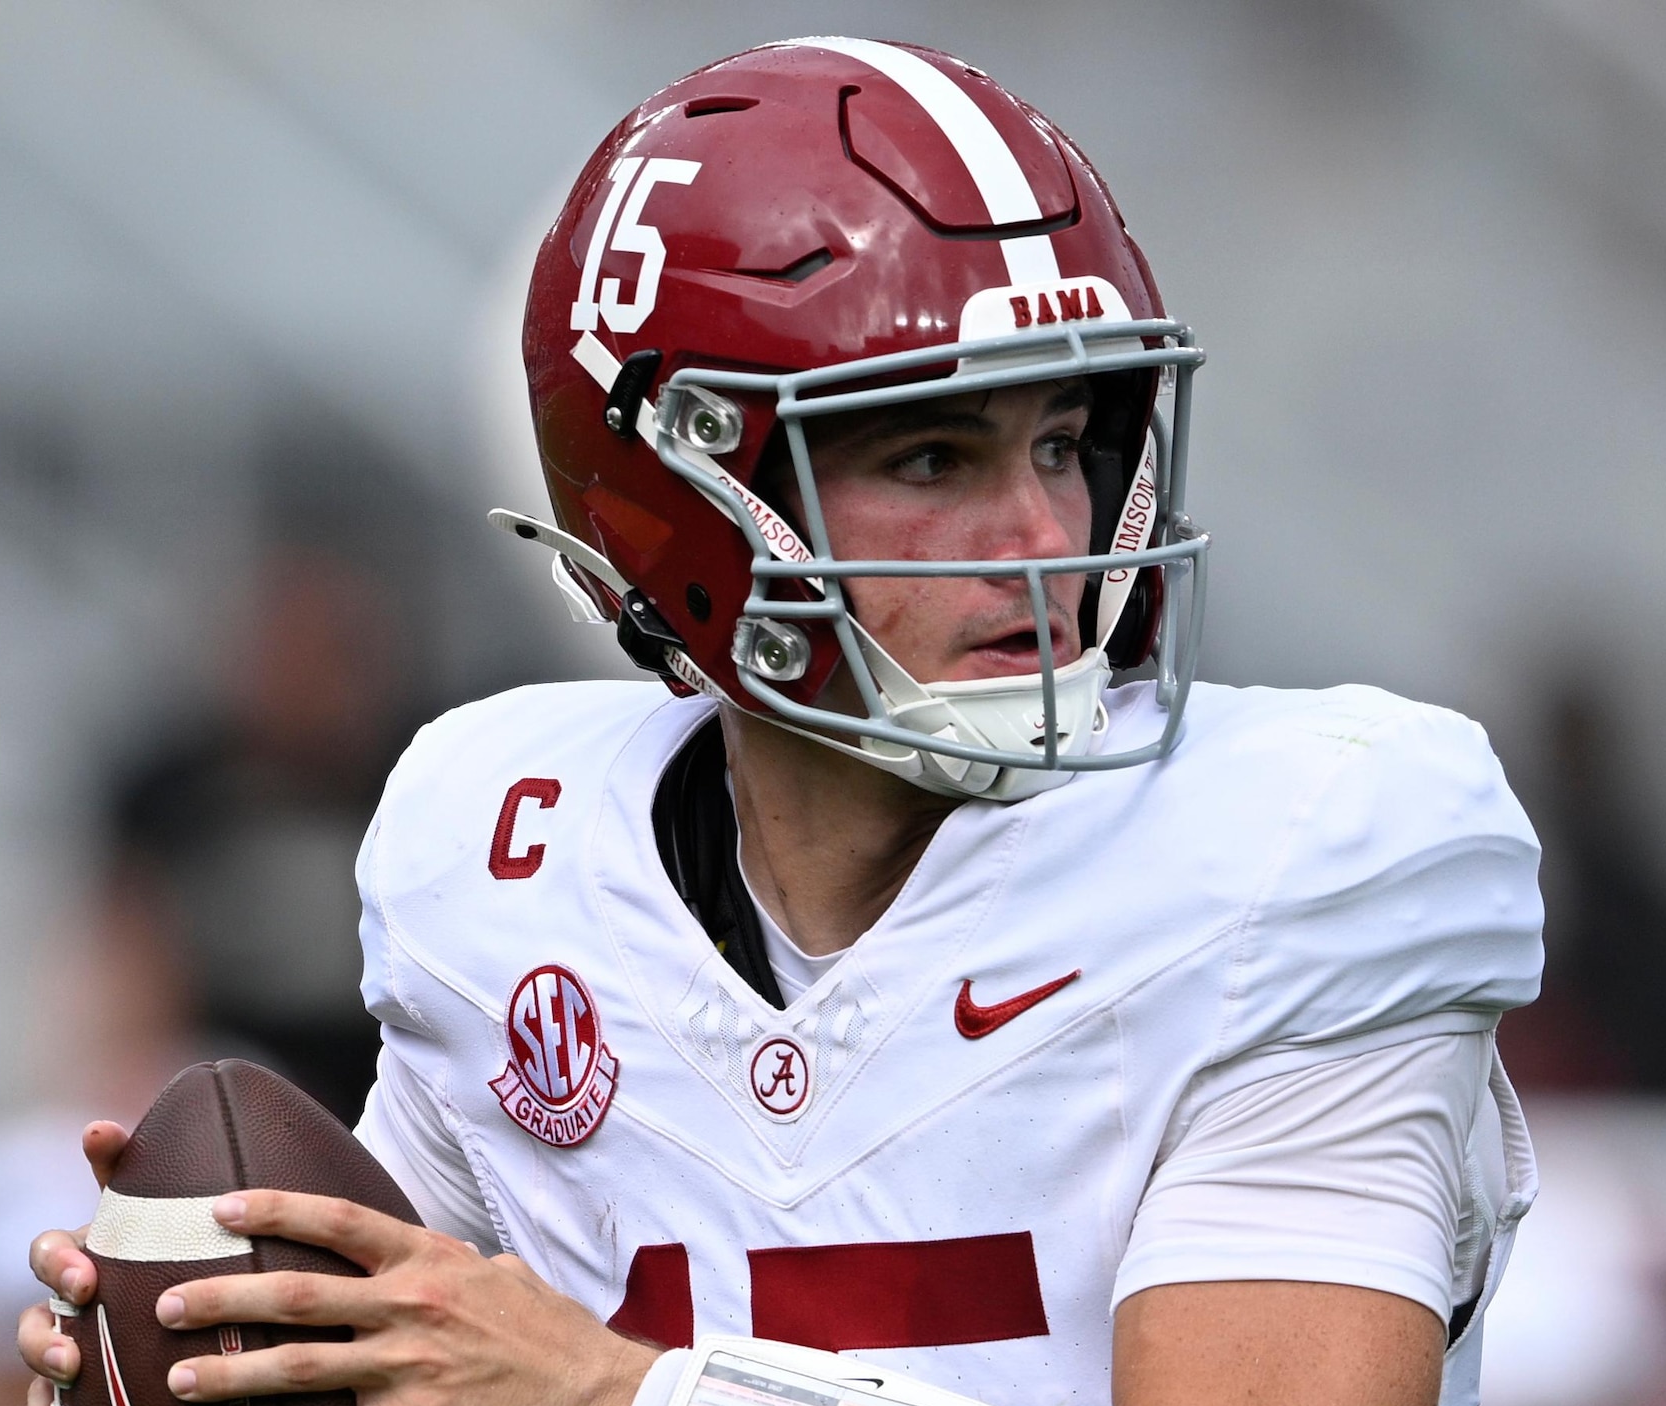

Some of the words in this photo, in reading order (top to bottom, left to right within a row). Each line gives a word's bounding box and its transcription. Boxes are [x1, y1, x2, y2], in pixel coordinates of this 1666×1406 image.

[570, 157, 702, 334] 15
[1009, 287, 1104, 328] BAMA
[1107, 475, 1155, 583] CIMSON
[488, 777, 562, 880] C
[513, 972, 591, 1098] SEC
[760, 1050, 796, 1097] A
[516, 1084, 604, 1142] GRADUATE
